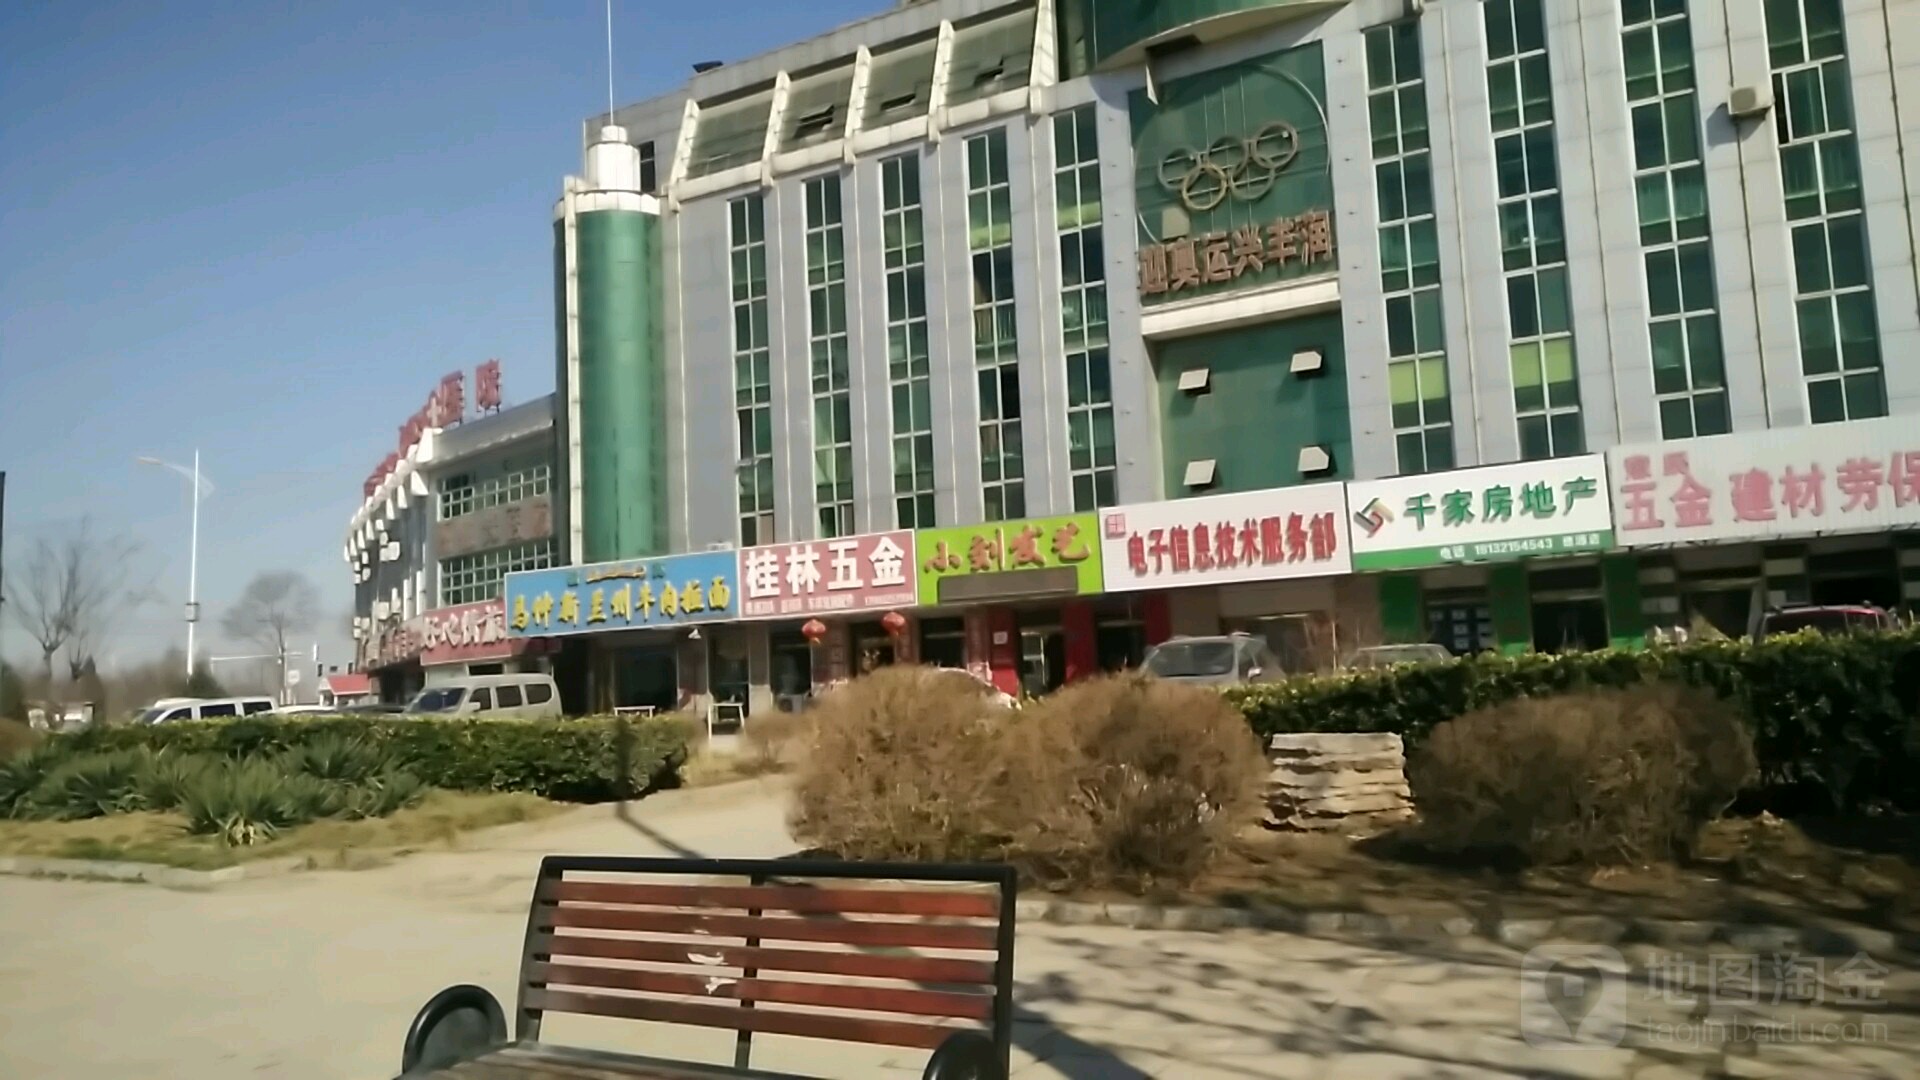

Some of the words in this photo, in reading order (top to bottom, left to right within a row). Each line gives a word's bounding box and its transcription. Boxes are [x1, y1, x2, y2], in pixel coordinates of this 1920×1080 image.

[1403, 476, 1597, 531] 千家房地产
[745, 536, 906, 598] 桂林五金
[1128, 512, 1337, 577] 电子信息技术服务部
